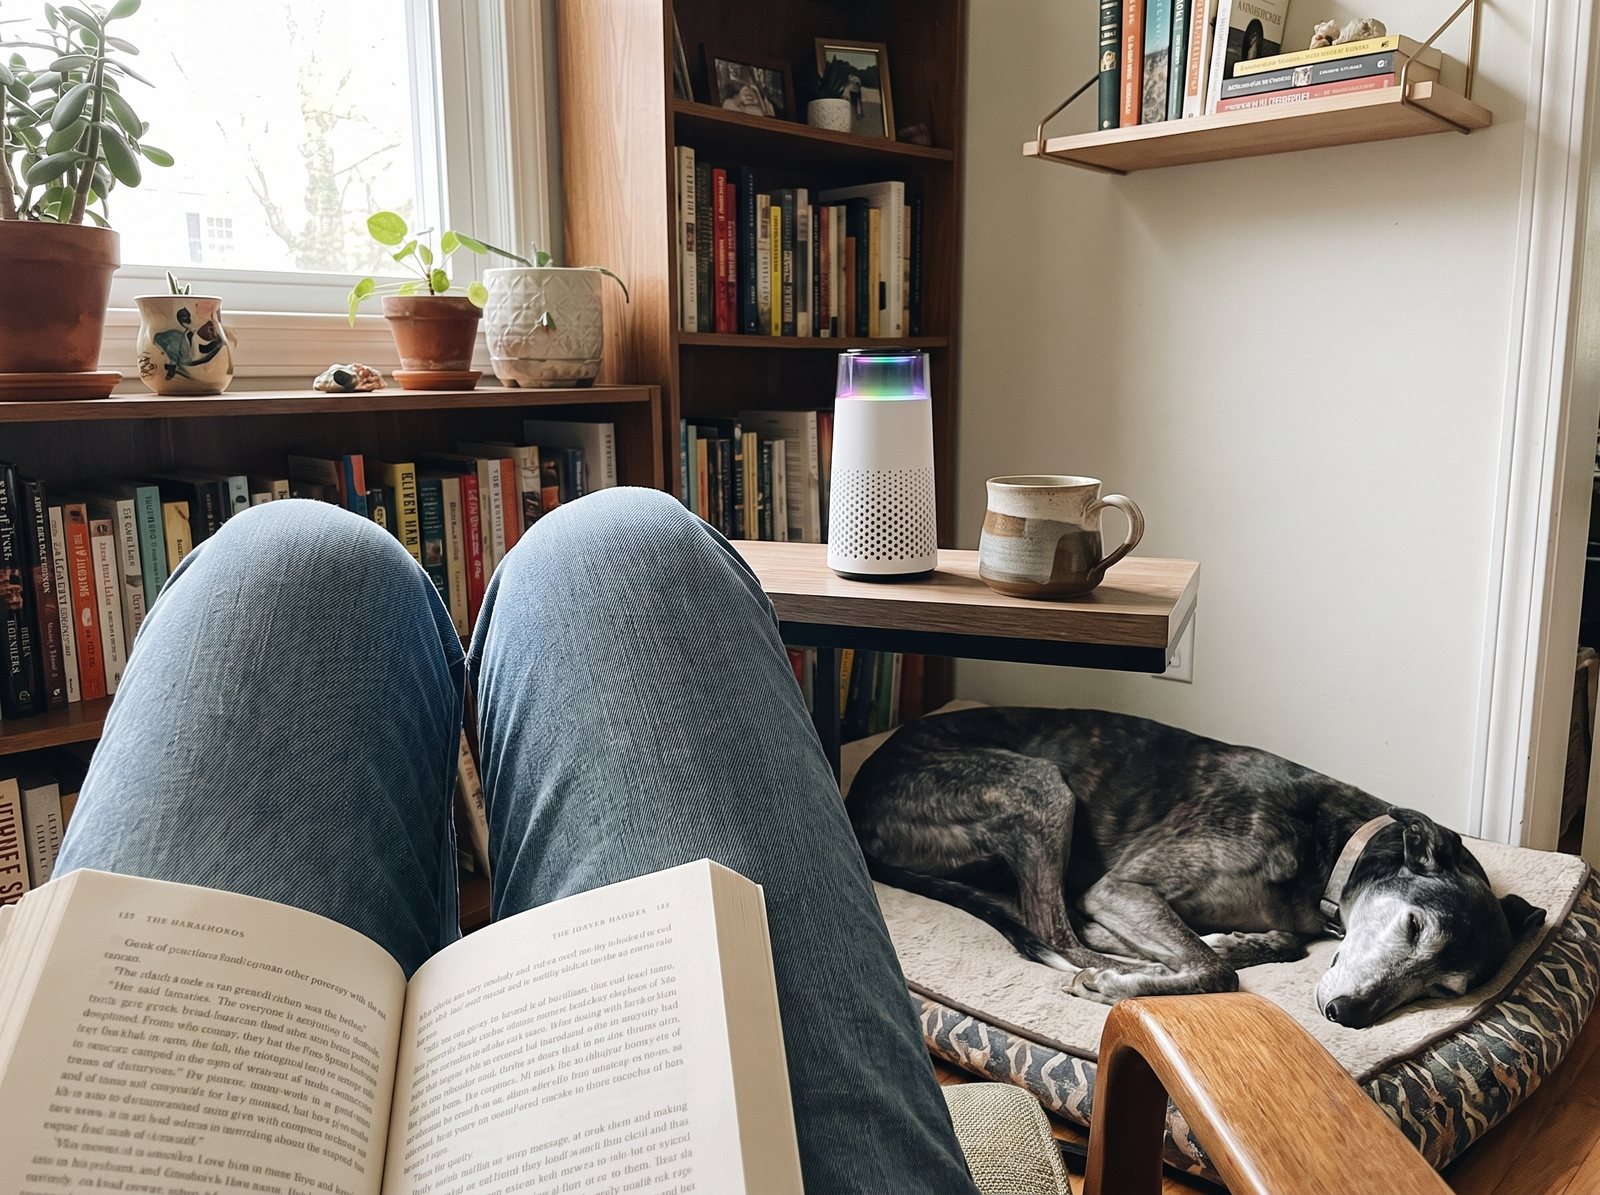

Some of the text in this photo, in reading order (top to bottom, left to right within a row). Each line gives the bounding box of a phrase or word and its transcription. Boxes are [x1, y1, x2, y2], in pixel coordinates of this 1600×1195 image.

[156, 944, 167, 952] of
[285, 967, 309, 981] other
[350, 992, 365, 1005] with
[515, 965, 530, 976] and
[138, 986, 160, 995] said
[218, 996, 237, 1008] The
[661, 1000, 678, 1012] had
[325, 1009, 337, 1020] the
[603, 1002, 622, 1015] with
[491, 1015, 499, 1023] to
[672, 1028, 681, 1037] of
[149, 1032, 158, 1041] in
[192, 1039, 208, 1049] the
[235, 1047, 250, 1056] the
[243, 1032, 264, 1045] they
[285, 1042, 300, 1052] the
[562, 1043, 579, 1054] that
[594, 1036, 604, 1044] no
[73, 1040, 83, 1048] to
[175, 1054, 185, 1062] in
[233, 1061, 243, 1070] of
[60, 1072, 83, 1081] and
[85, 1073, 97, 1082] of
[102, 1059, 114, 1068] of
[312, 1095, 320, 1105] in
[575, 1086, 584, 1094] to
[109, 1093, 120, 1102] to
[257, 1114, 278, 1127] with
[530, 1136, 570, 1153] message,
[573, 1132, 581, 1141] at
[608, 1119, 631, 1130] them
[634, 1111, 650, 1123] and
[653, 1103, 688, 1118] making
[210, 1124, 220, 1133] in
[307, 1142, 319, 1153] the
[522, 1158, 543, 1172] they
[650, 1122, 667, 1135] and
[252, 1165, 262, 1174] in
[624, 1161, 651, 1174] them.
